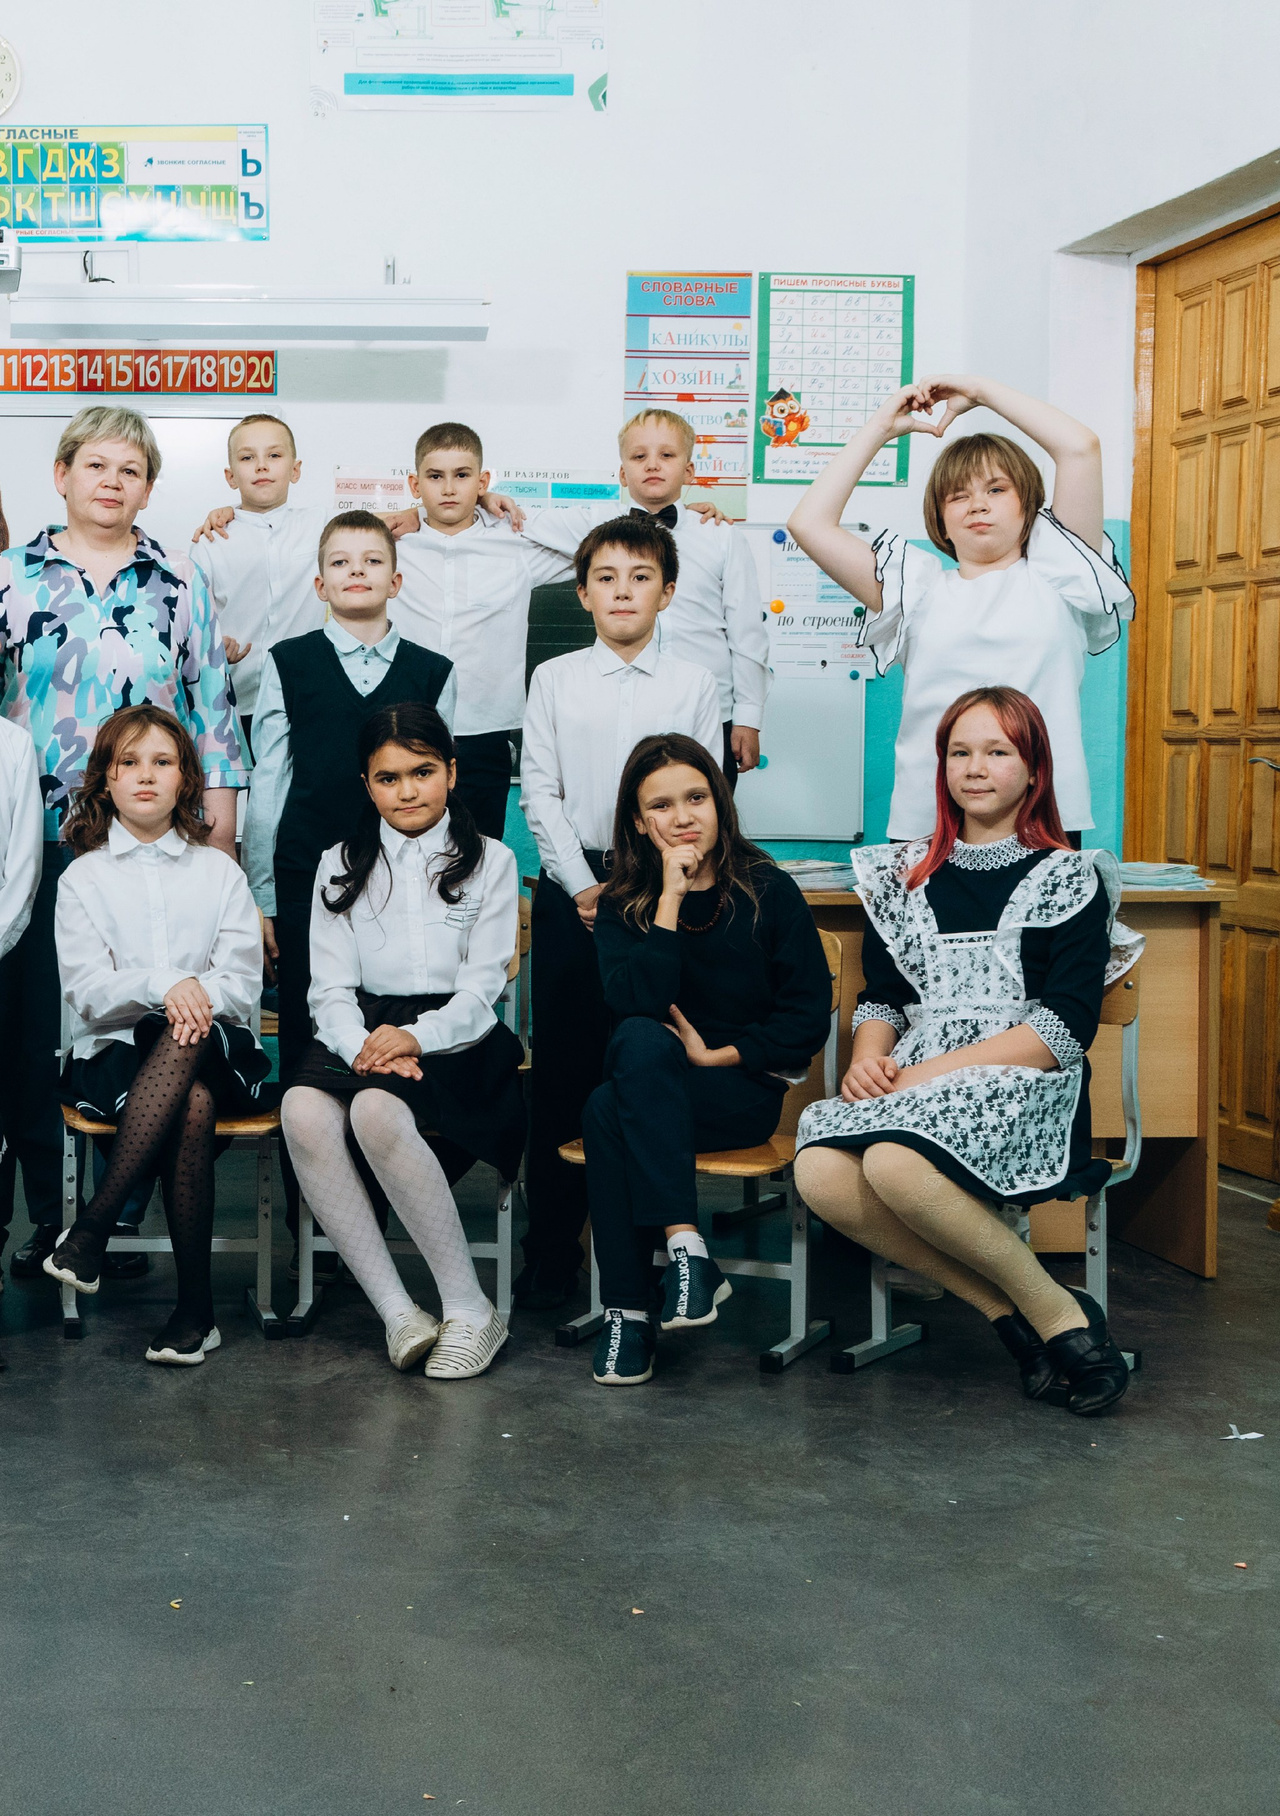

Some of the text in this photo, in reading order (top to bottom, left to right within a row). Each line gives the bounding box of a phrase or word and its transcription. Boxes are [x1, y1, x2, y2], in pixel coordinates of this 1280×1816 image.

[0, 54, 6, 64] 2
[5, 72, 12, 81] 3
[641, 281, 738, 293] СЛОВАРНЫЕ
[812, 279, 866, 288] ПРОПИСНЫЕ
[870, 280, 900, 288] БУКВЫ
[663, 294, 716, 306] СЛОВА
[20, 355, 48, 386] 12
[50, 355, 76, 386] 13
[77, 355, 104, 386] 14
[106, 355, 133, 386] 15
[134, 355, 160, 386] 16
[162, 355, 190, 386] 17
[190, 355, 218, 387] 18
[220, 356, 246, 387] 19
[247, 356, 273, 387] 20
[777, 616, 794, 626] по
